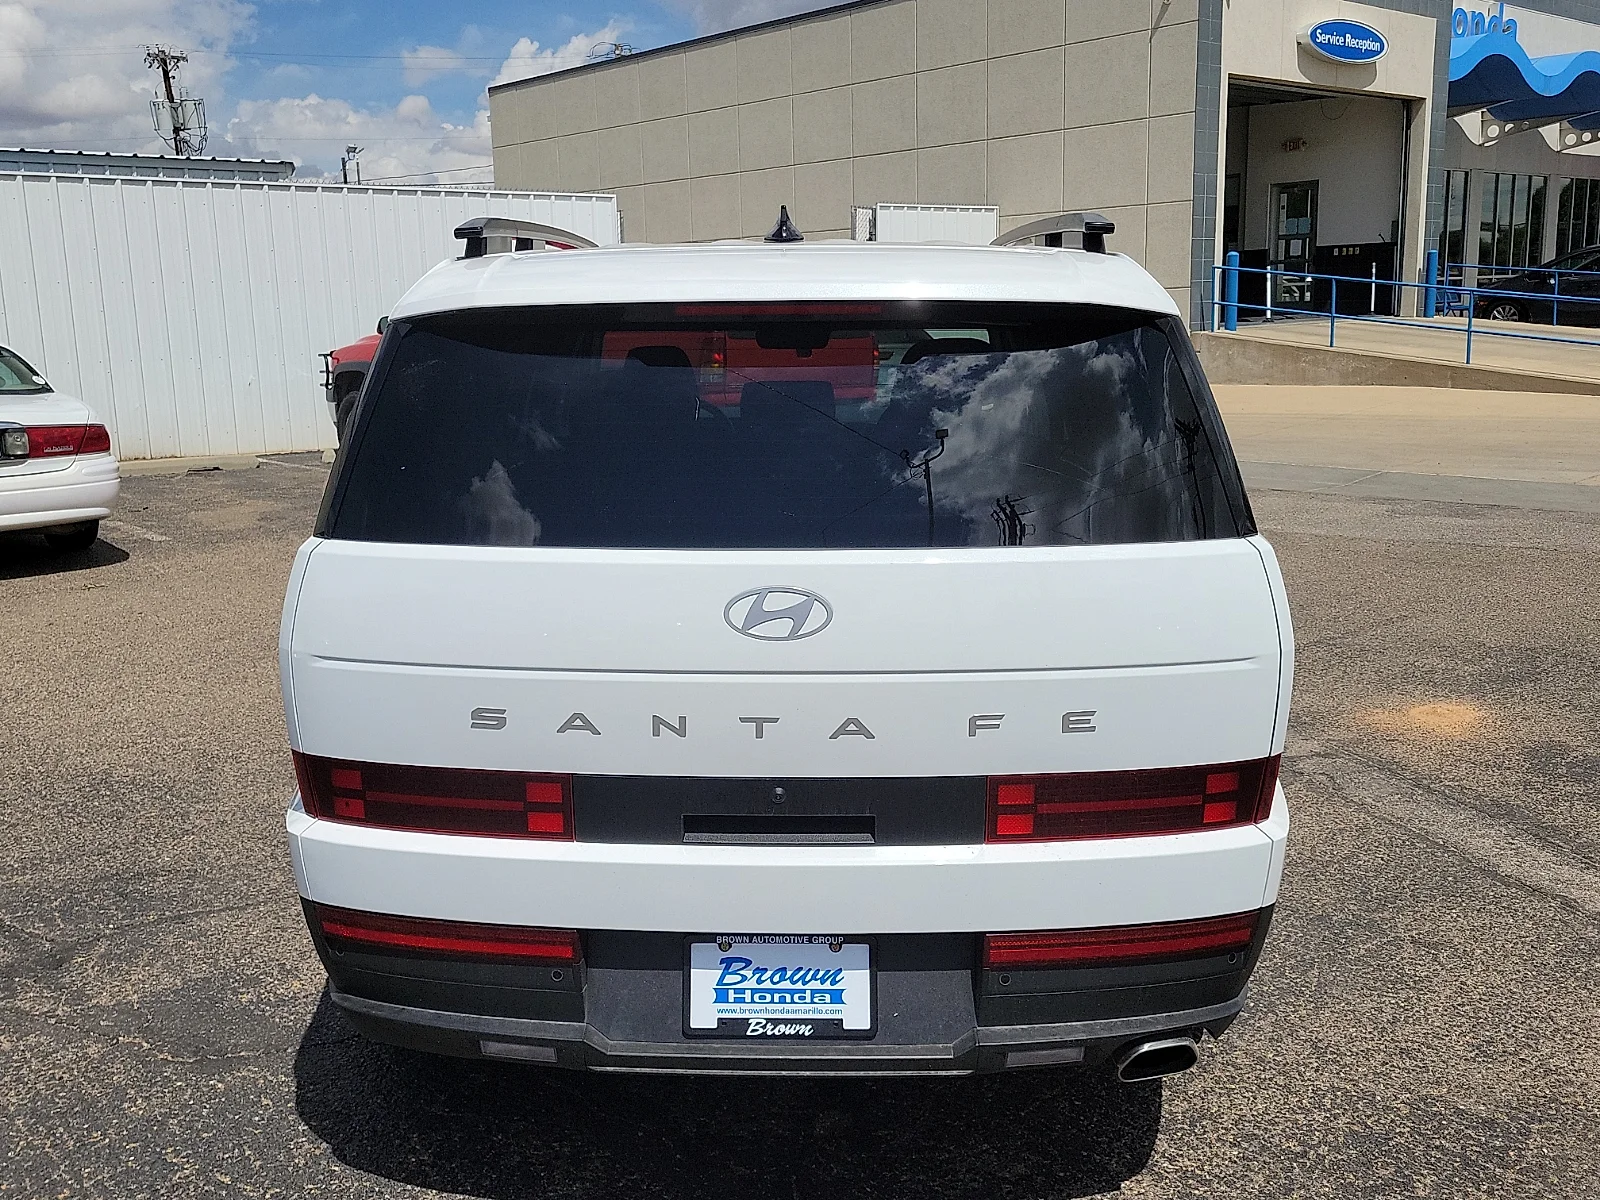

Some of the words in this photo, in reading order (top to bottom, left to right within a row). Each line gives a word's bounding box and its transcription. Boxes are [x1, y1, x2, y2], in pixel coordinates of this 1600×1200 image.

[1453, 3, 1517, 41] onda
[1315, 28, 1344, 46] Service
[1345, 33, 1381, 53] Reception
[471, 707, 876, 739] SANTA
[968, 710, 1098, 737] FE
[716, 936, 750, 944] BROWN
[751, 936, 809, 944] AUTOMOTIVE
[811, 936, 845, 944] GROUP
[715, 956, 845, 987] Brown
[727, 988, 831, 1004] Honda
[716, 1006, 843, 1016] www.brownhondaamarillo.com
[745, 1018, 815, 1037] Brown
